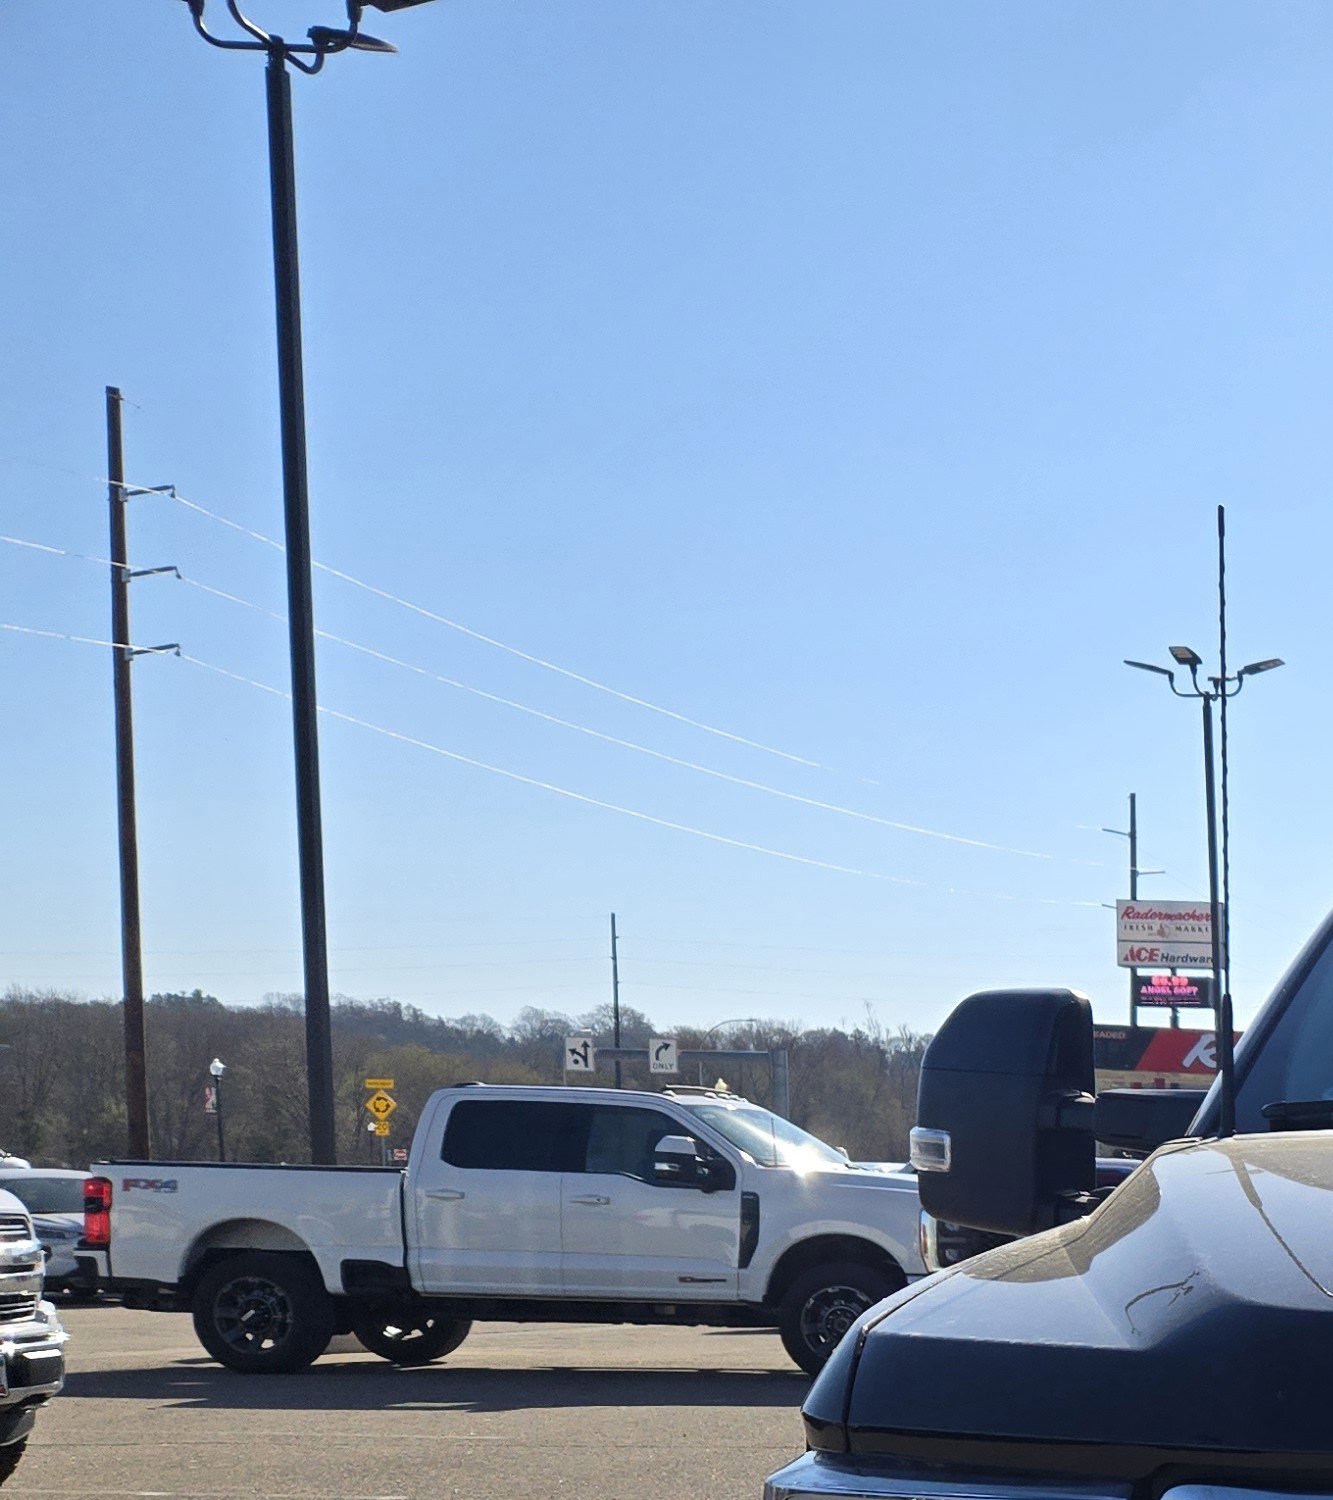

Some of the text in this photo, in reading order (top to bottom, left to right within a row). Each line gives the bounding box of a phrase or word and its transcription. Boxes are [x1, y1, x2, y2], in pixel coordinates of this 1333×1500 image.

[1175, 925, 1210, 933] MARKE
[1123, 945, 1213, 964] ACE Hardwar
[1094, 1030, 1126, 1040] EADED
[652, 1062, 674, 1071] ONLY
[122, 1178, 178, 1193] FX4
